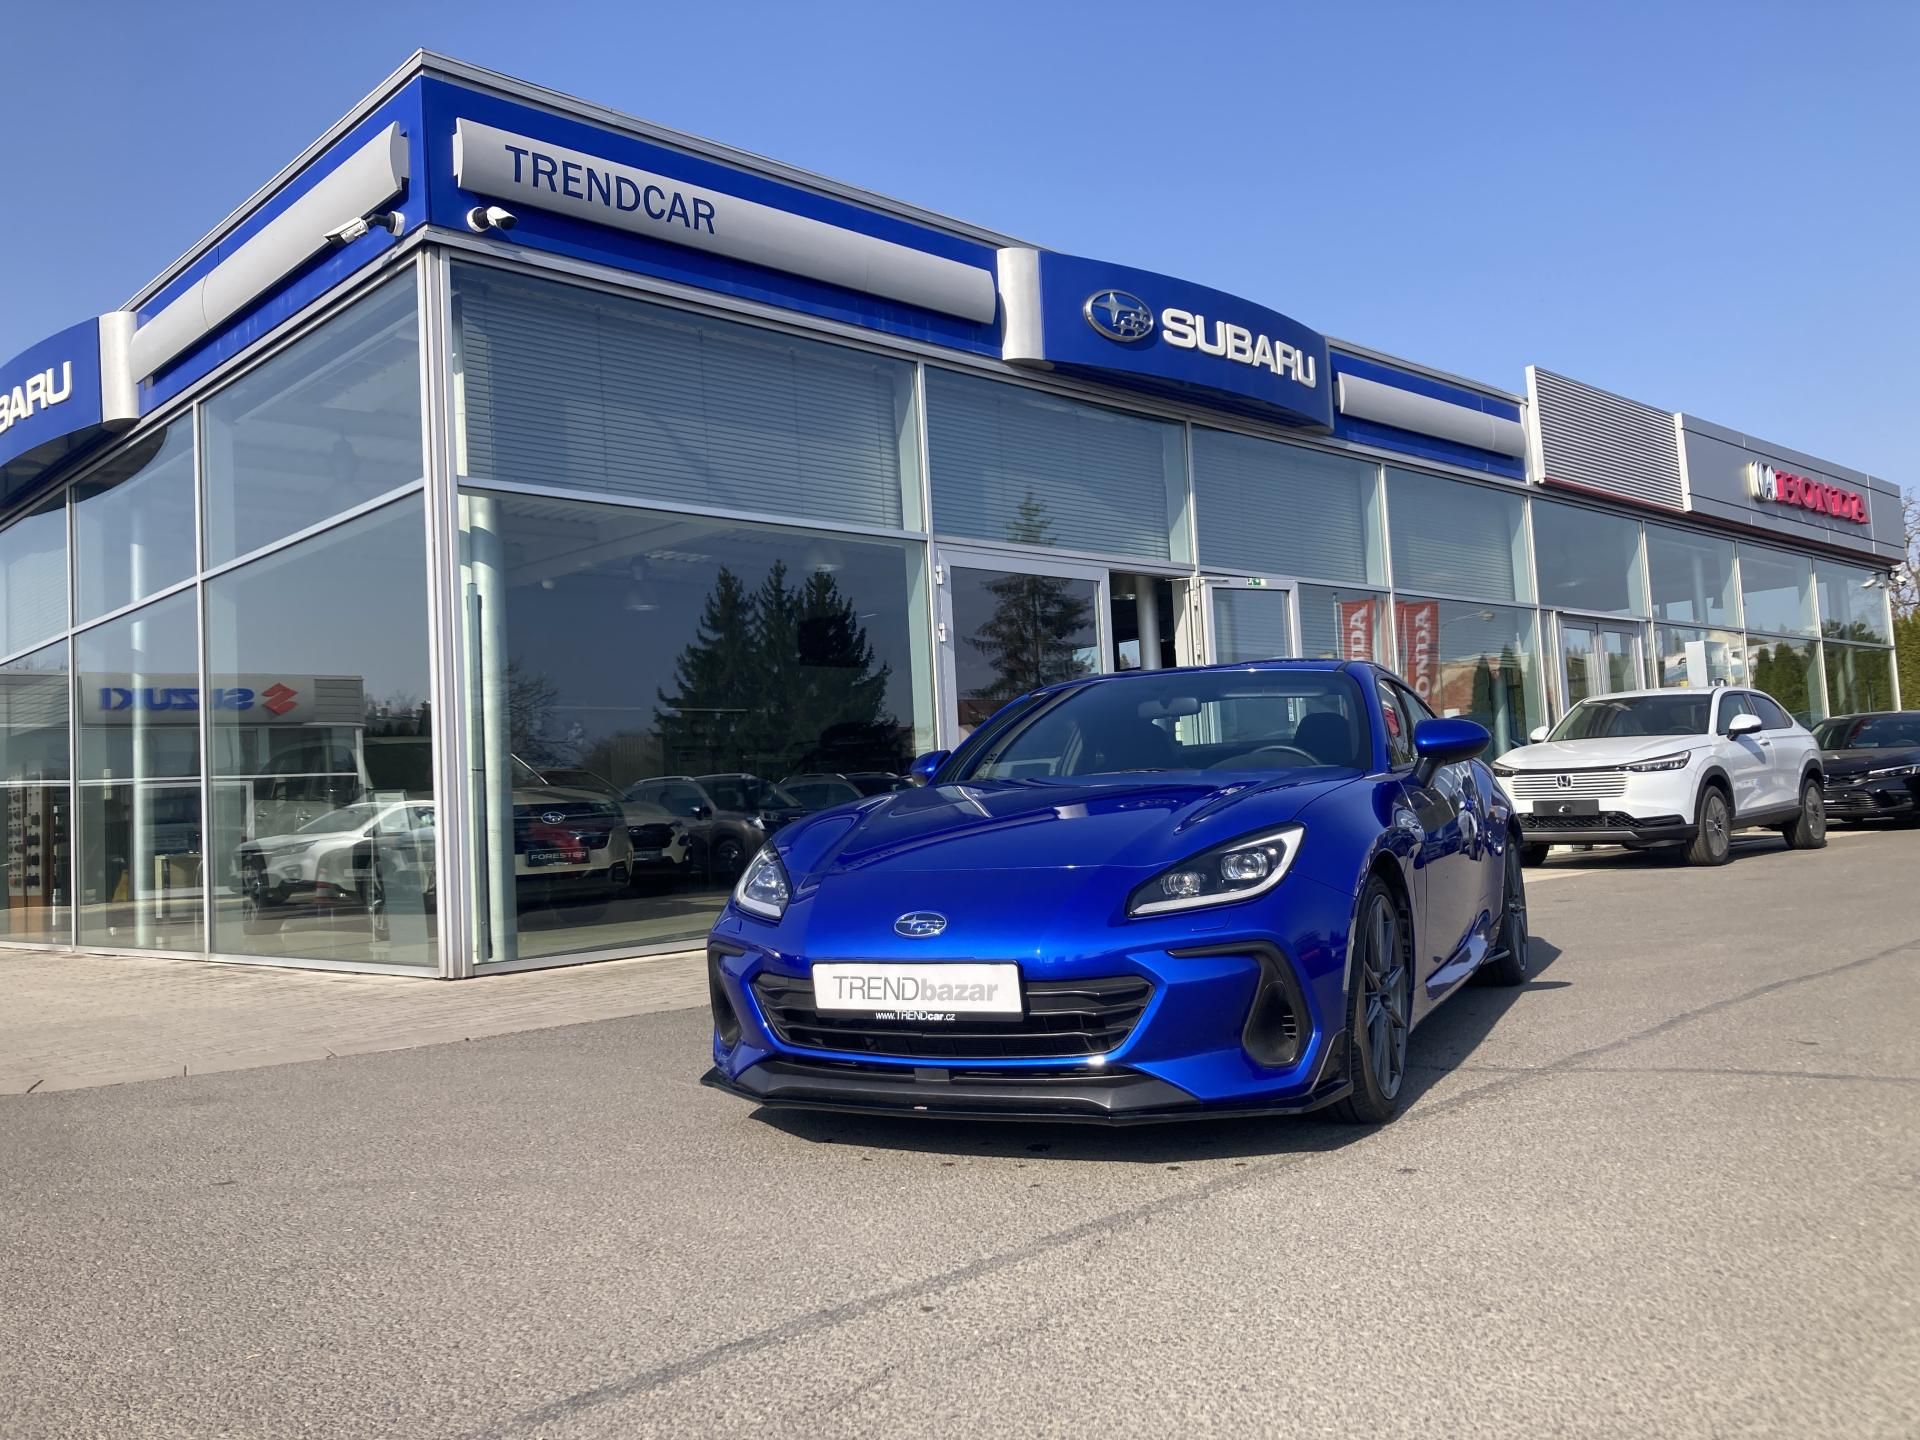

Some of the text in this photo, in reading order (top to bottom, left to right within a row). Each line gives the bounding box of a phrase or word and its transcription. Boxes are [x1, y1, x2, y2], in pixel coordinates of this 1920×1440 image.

[504, 144, 715, 235] TRENDCAR
[1161, 308, 1317, 389] SUBARU
[1775, 469, 1870, 525] HONDA
[1415, 605, 1431, 699] ONDA
[531, 850, 587, 861] FORESTER
[832, 975, 999, 1002] TRENDbazar
[875, 1010, 956, 1021] www.TRENDcar.cz
